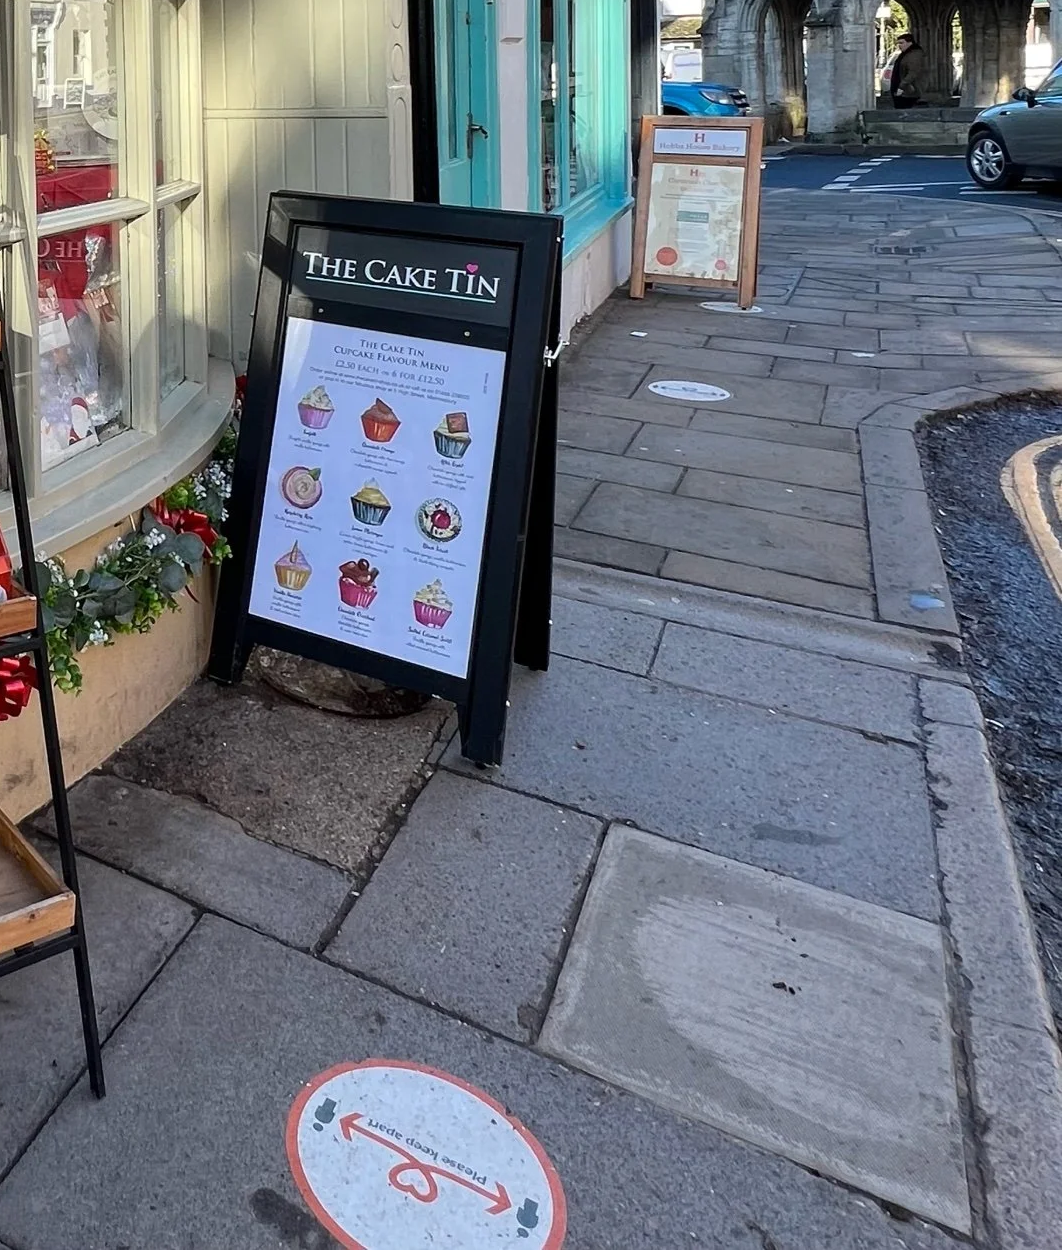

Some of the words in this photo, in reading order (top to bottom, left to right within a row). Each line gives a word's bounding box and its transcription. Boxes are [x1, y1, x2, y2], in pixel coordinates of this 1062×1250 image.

[694, 133, 705, 143] H
[302, 251, 356, 280] THE
[364, 259, 437, 290] CAKE
[333, 345, 374, 360] CUPCAKE
[377, 352, 418, 367] FLAVOUR
[420, 360, 450, 373] MENU
[360, 338, 378, 350] THE
[380, 342, 405, 355] CAKE
[408, 346, 425, 358] TIN
[335, 359, 356, 370] £2.50
[357, 364, 380, 375] EACH
[399, 371, 416, 381] FOR
[417, 373, 445, 386] £12.50
[367, 1118, 403, 1141] apart
[405, 1137, 439, 1161] keep
[441, 1155, 488, 1186] please
